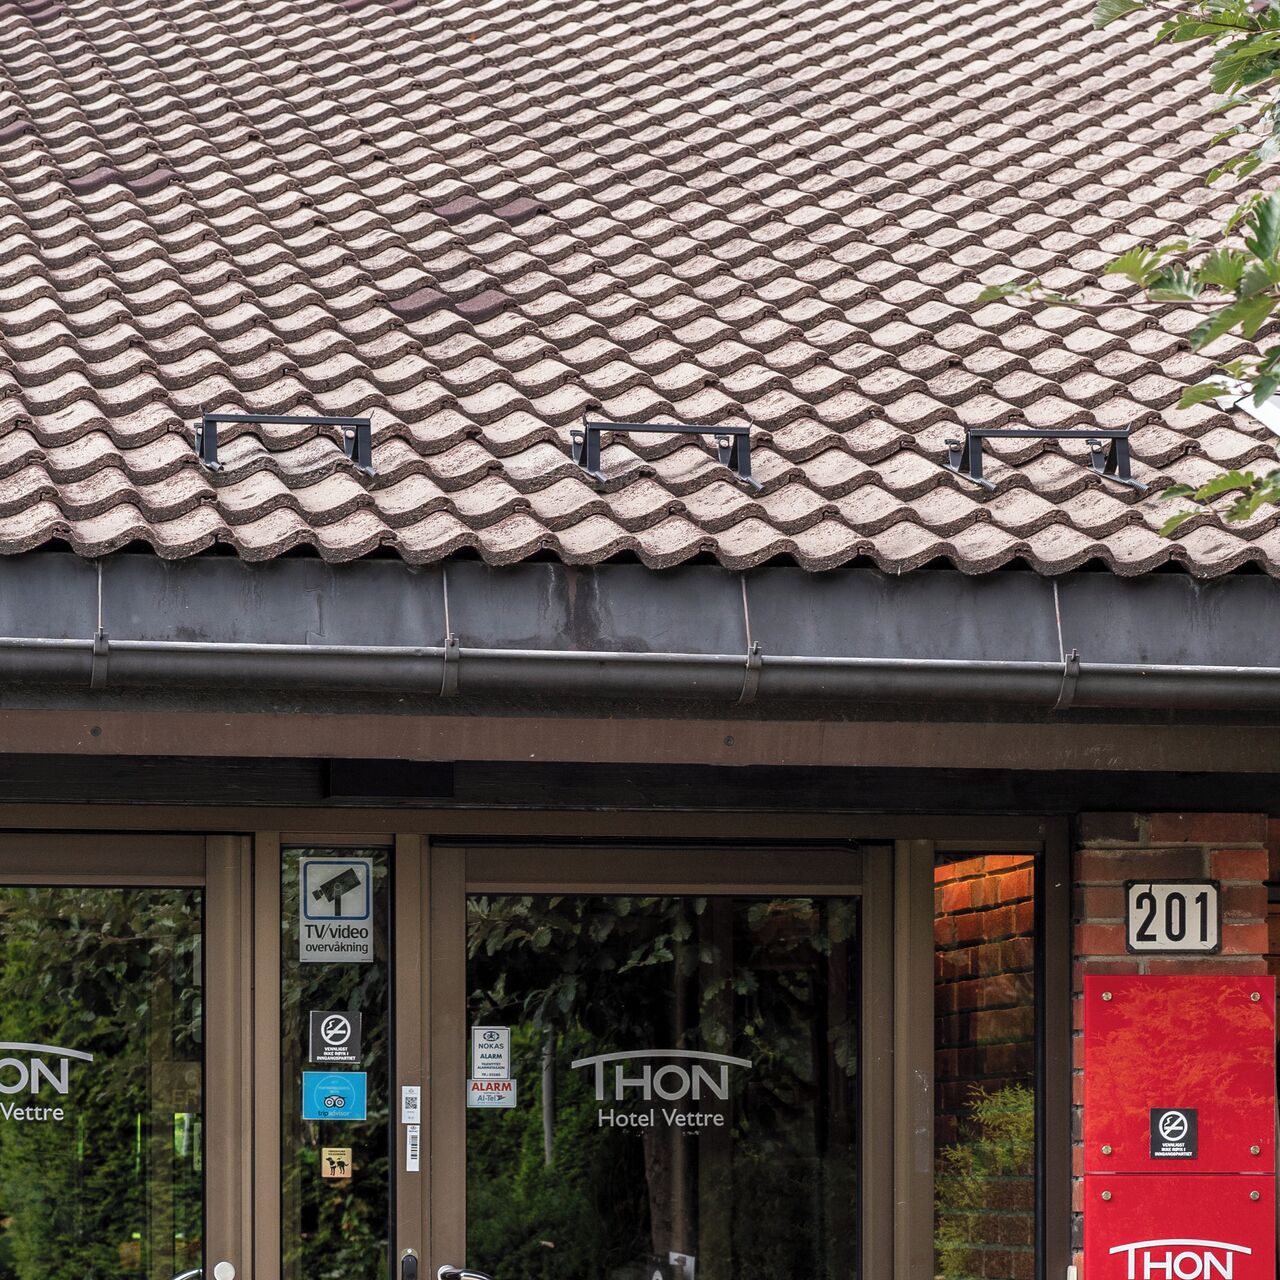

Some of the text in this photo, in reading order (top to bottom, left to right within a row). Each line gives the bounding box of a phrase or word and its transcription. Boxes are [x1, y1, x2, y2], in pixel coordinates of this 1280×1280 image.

[1136, 891, 1208, 942] 201
[304, 923, 369, 940] TV/video
[305, 941, 369, 954] overvåkning
[571, 1049, 753, 1101] THON
[471, 1082, 512, 1091] ALARM
[0, 1102, 65, 1121] Vettre
[598, 1109, 725, 1127] Hotel Vettre
[1109, 1238, 1252, 1280] THON
